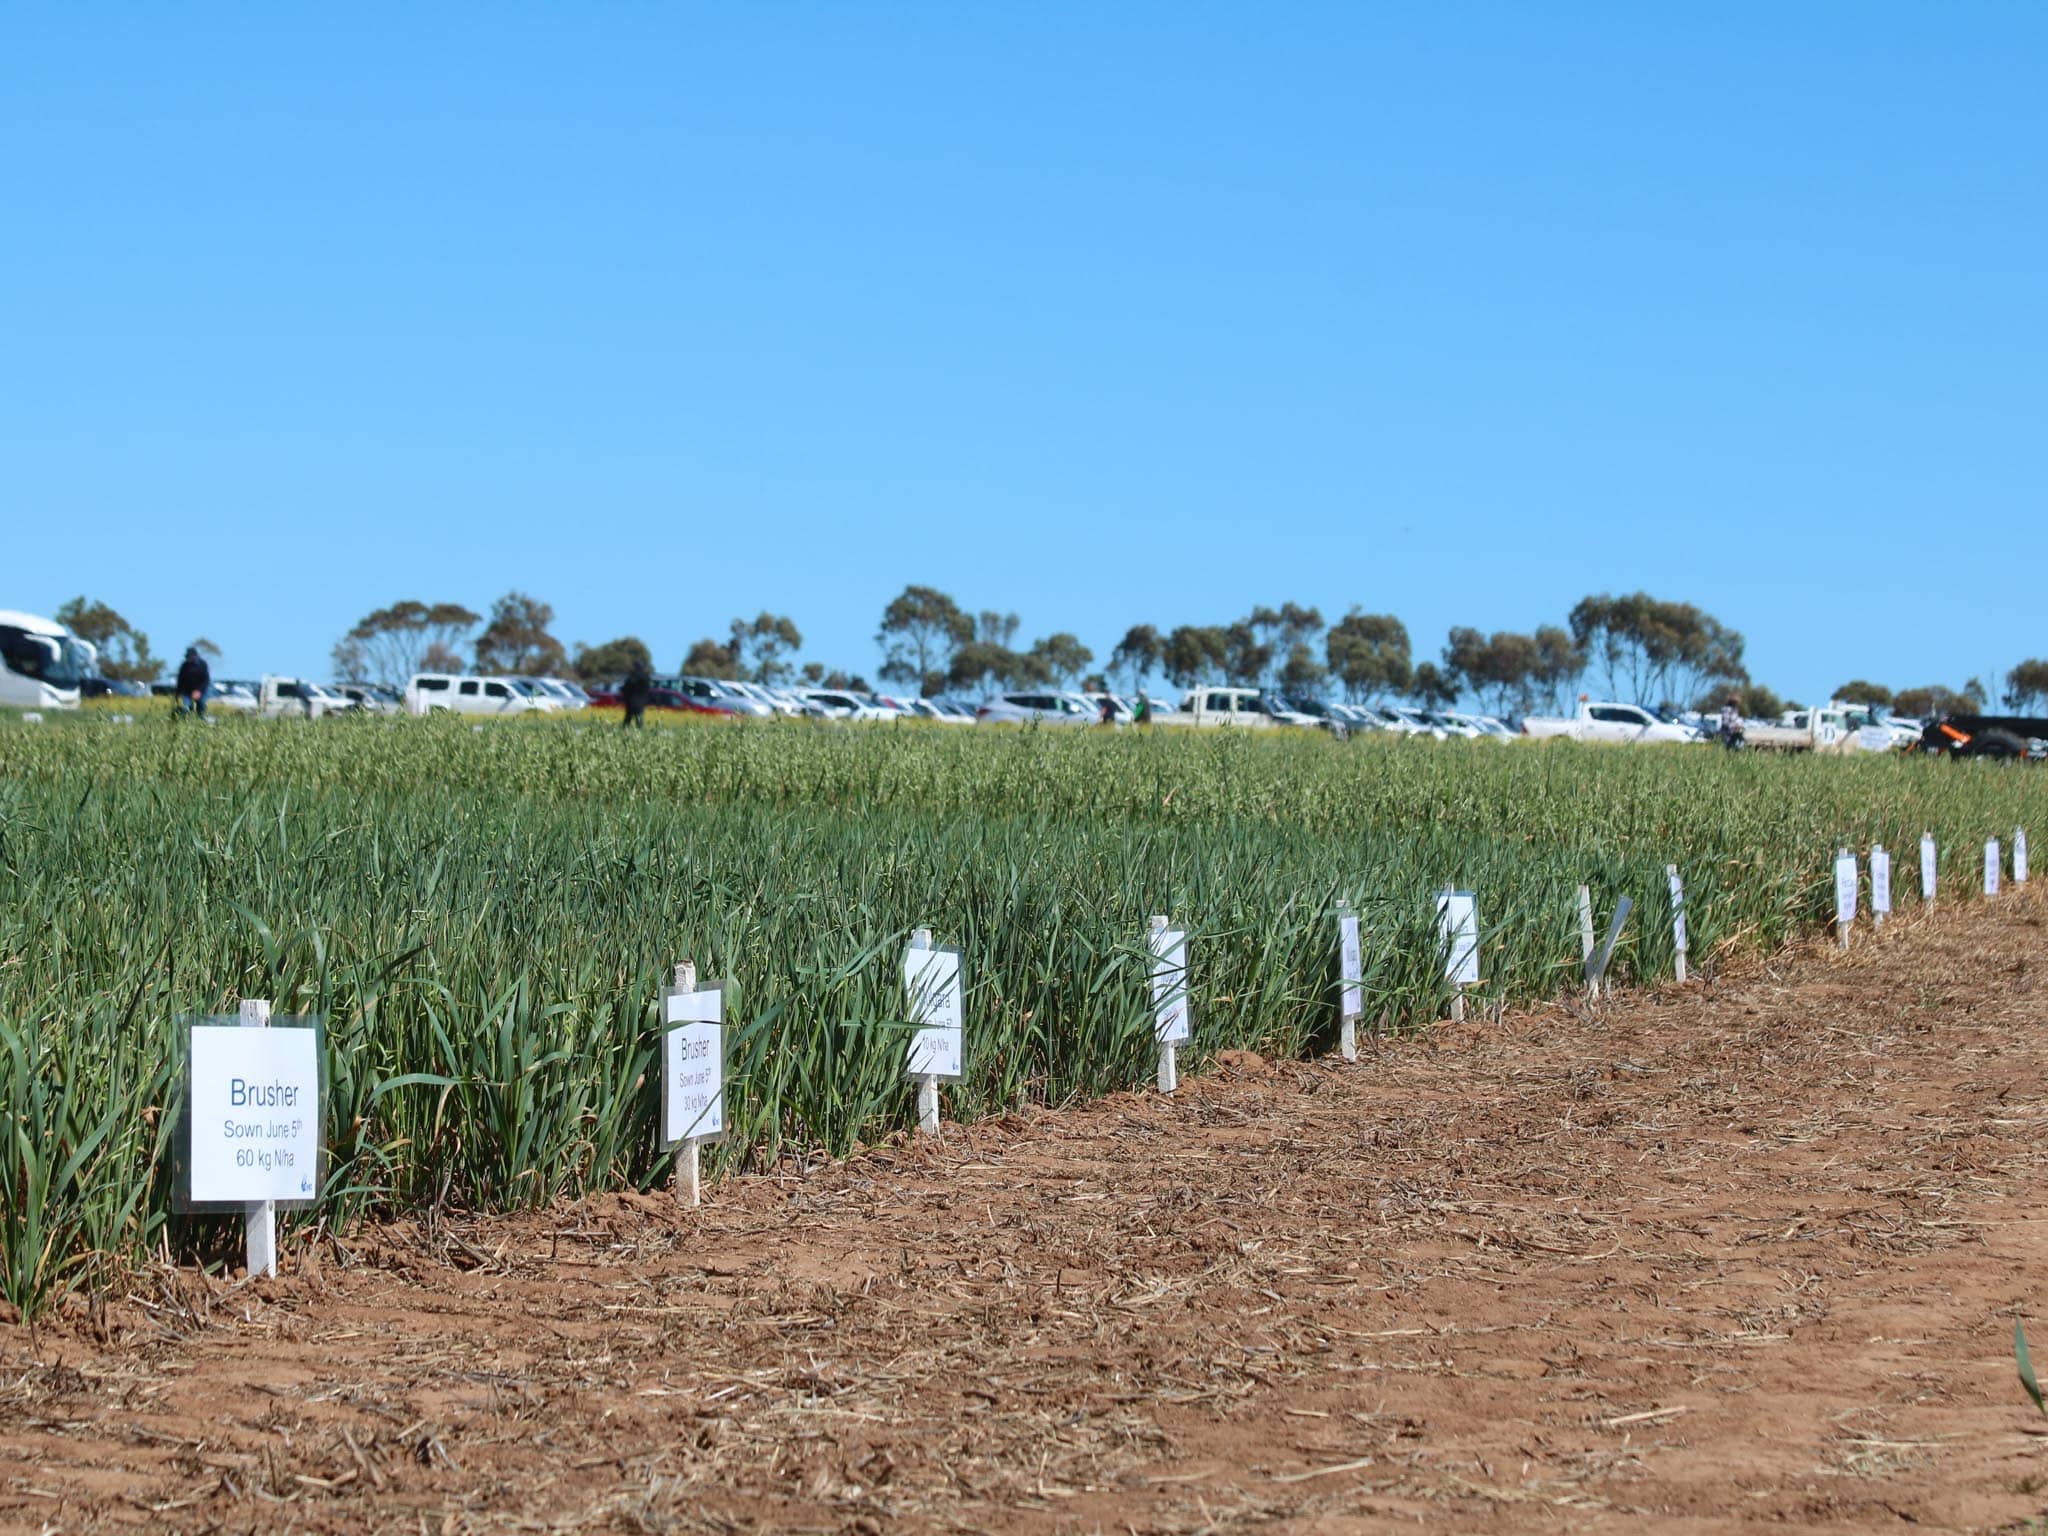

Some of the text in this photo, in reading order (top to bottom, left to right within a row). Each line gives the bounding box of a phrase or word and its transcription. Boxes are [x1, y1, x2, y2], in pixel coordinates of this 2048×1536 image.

[681, 1035, 710, 1061] Brusher
[231, 1078, 299, 1107] Brusher
[223, 1119, 263, 1138] Sown
[266, 1119, 289, 1139] June
[236, 1148, 294, 1171] 60 kg N/ha
